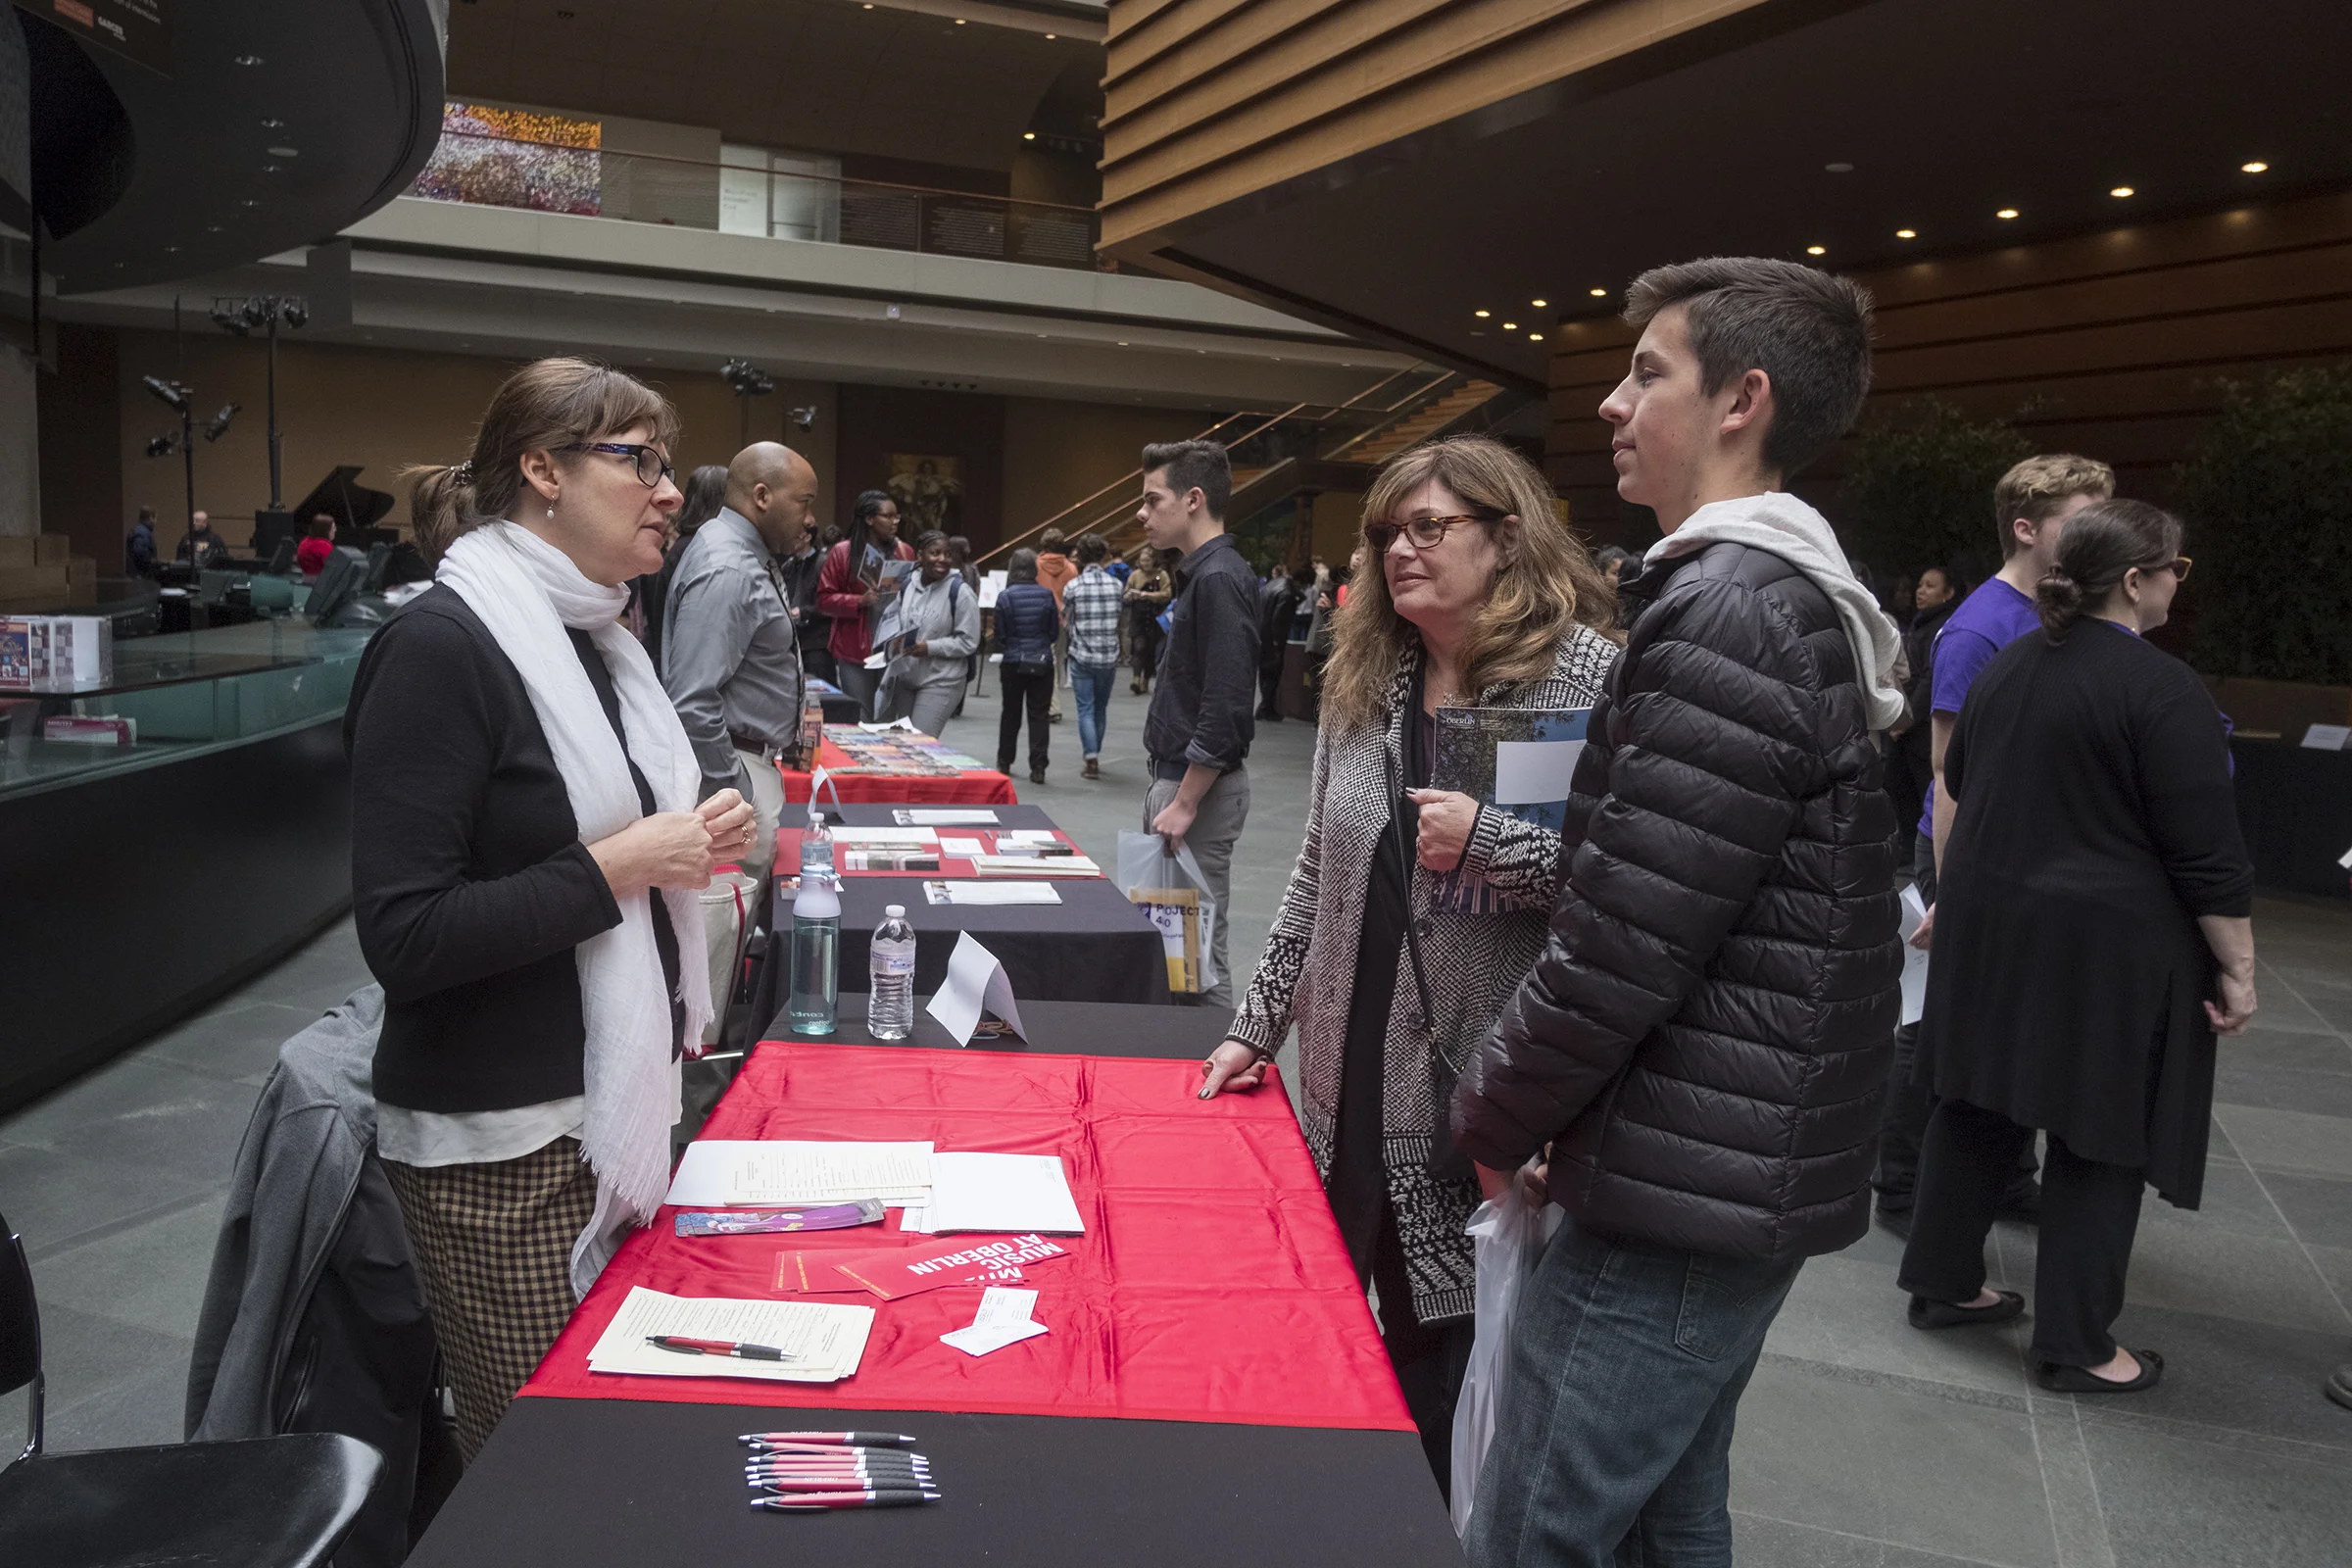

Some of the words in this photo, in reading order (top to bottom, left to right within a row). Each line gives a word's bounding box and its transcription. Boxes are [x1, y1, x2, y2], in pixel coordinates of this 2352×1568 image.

[1446, 716, 1476, 726] OBERLIN
[1012, 1233, 1044, 1250] AT
[906, 1239, 1016, 1275] OBERLIN
[980, 1242, 1064, 1271] MUSIC
